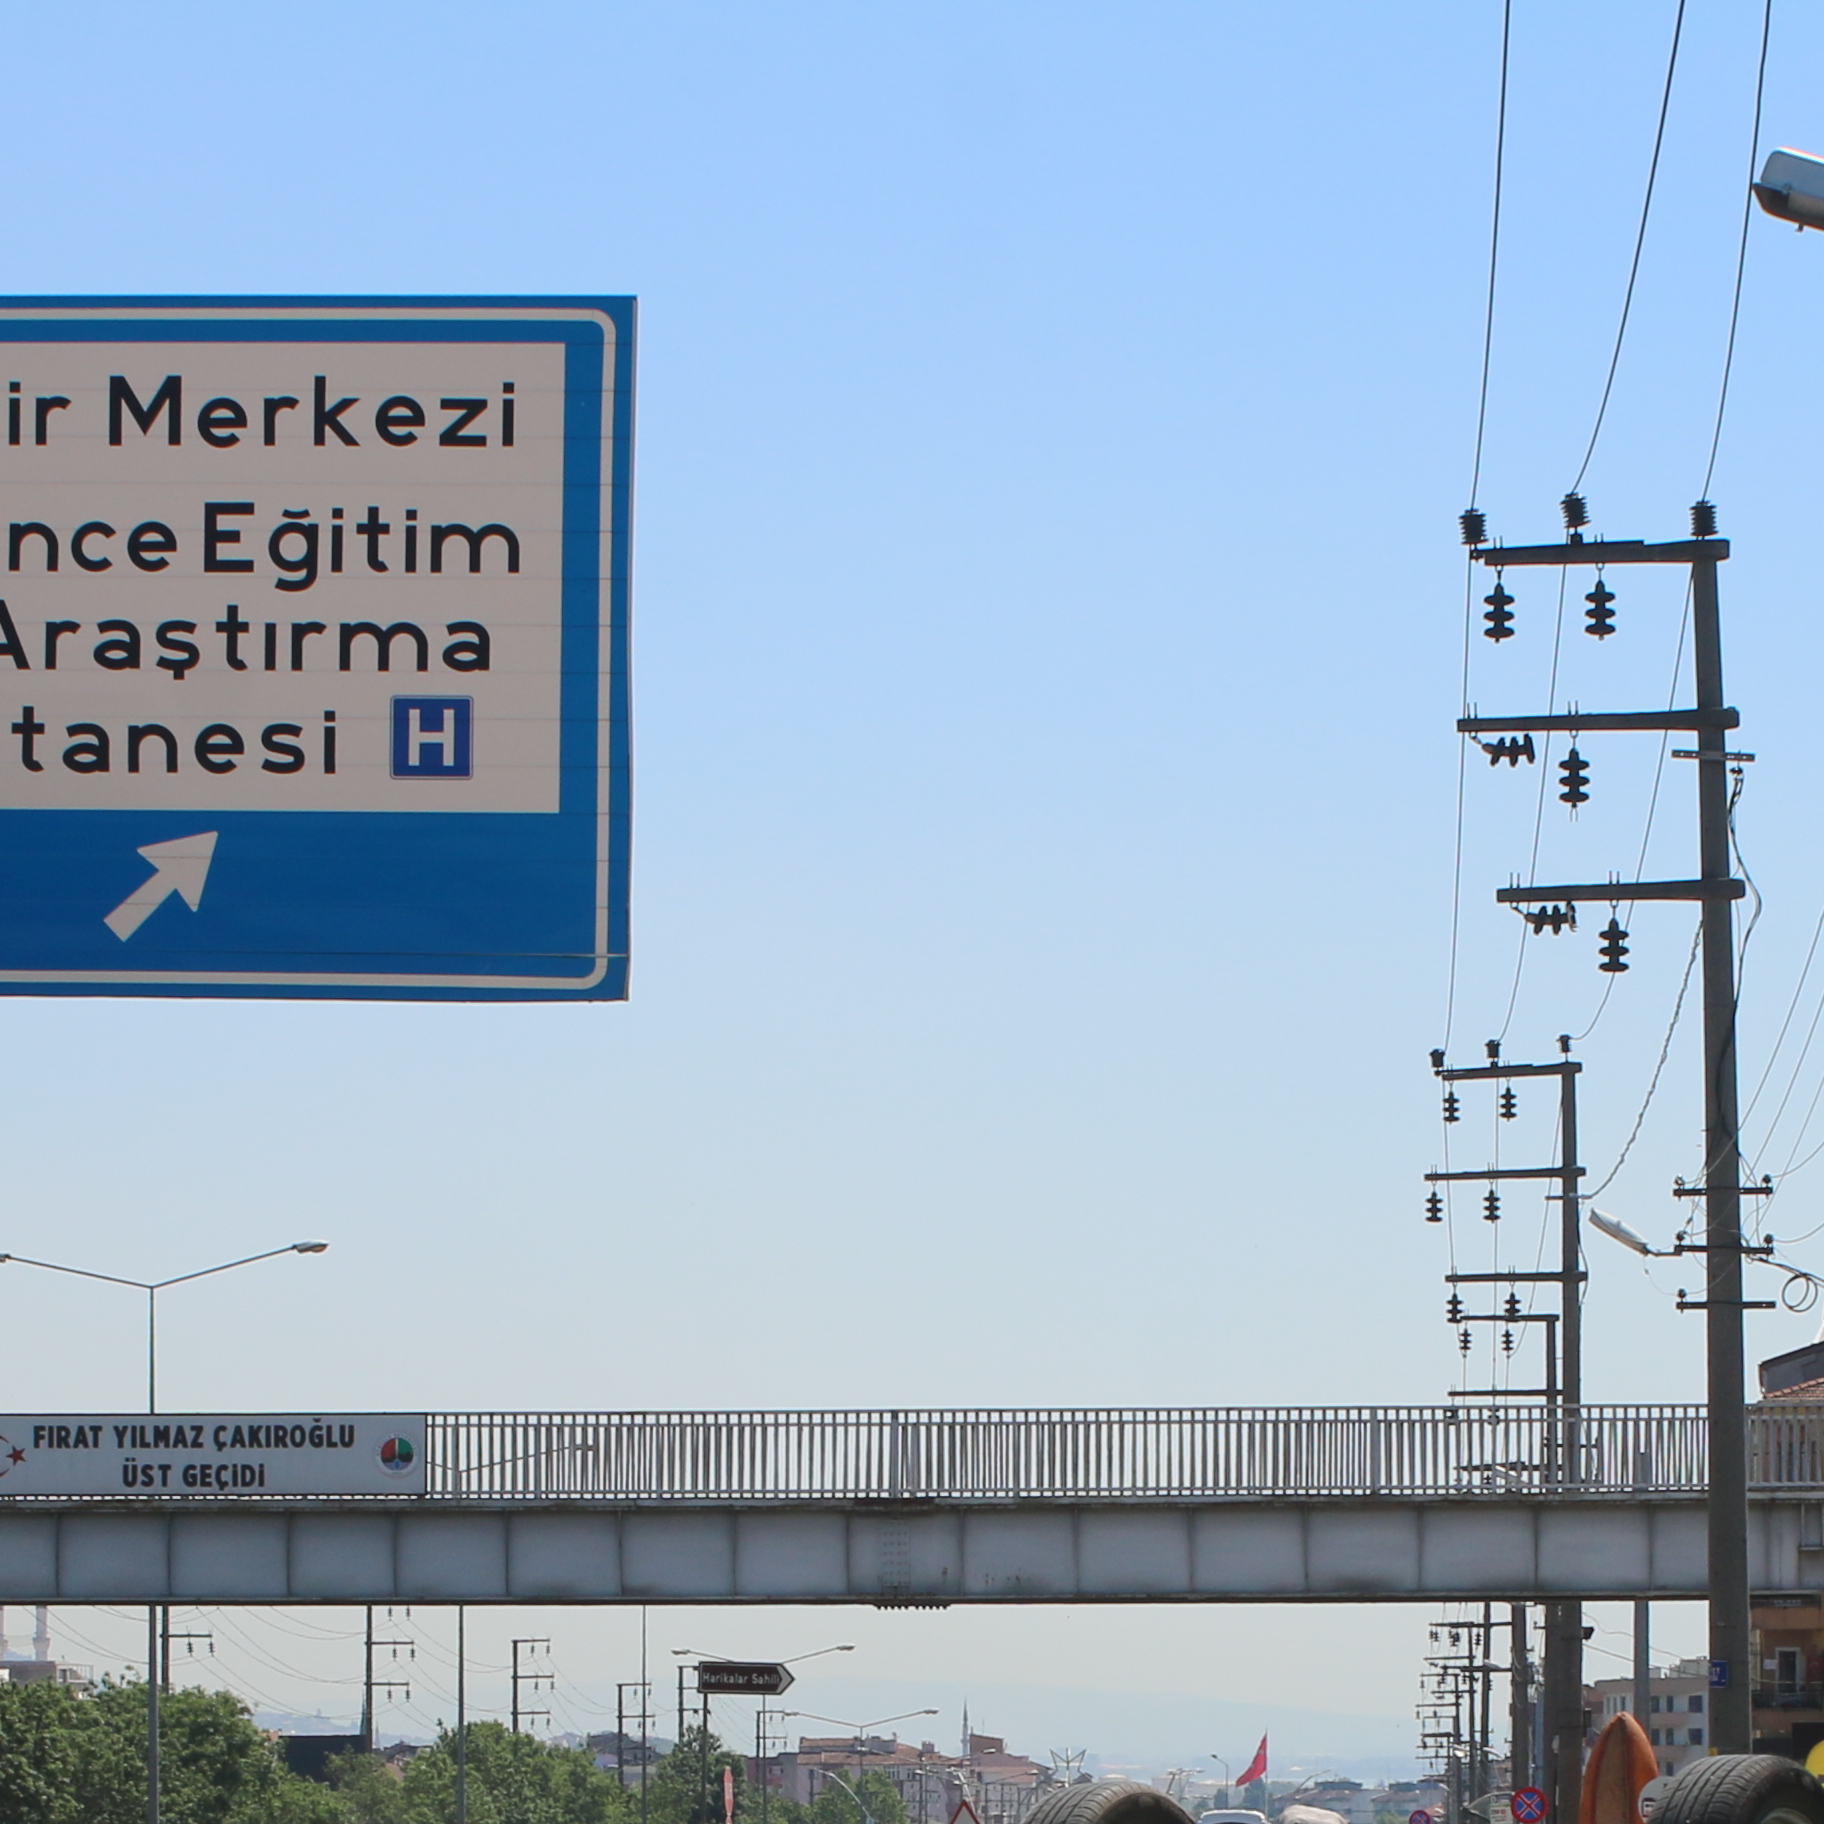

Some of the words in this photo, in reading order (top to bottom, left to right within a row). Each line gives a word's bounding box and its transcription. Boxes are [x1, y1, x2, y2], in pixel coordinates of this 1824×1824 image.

[108, 375, 517, 450] Merkezi
[203, 500, 522, 592] Eğitim
[406, 707, 457, 768] H
[33, 1425, 103, 1449] FIRAT
[115, 1425, 204, 1449] YILMAZ
[213, 1418, 355, 1454] ÇAKIROĞLU
[122, 1458, 172, 1488] ÜST
[182, 1463, 266, 1492] GEÇİDİ
